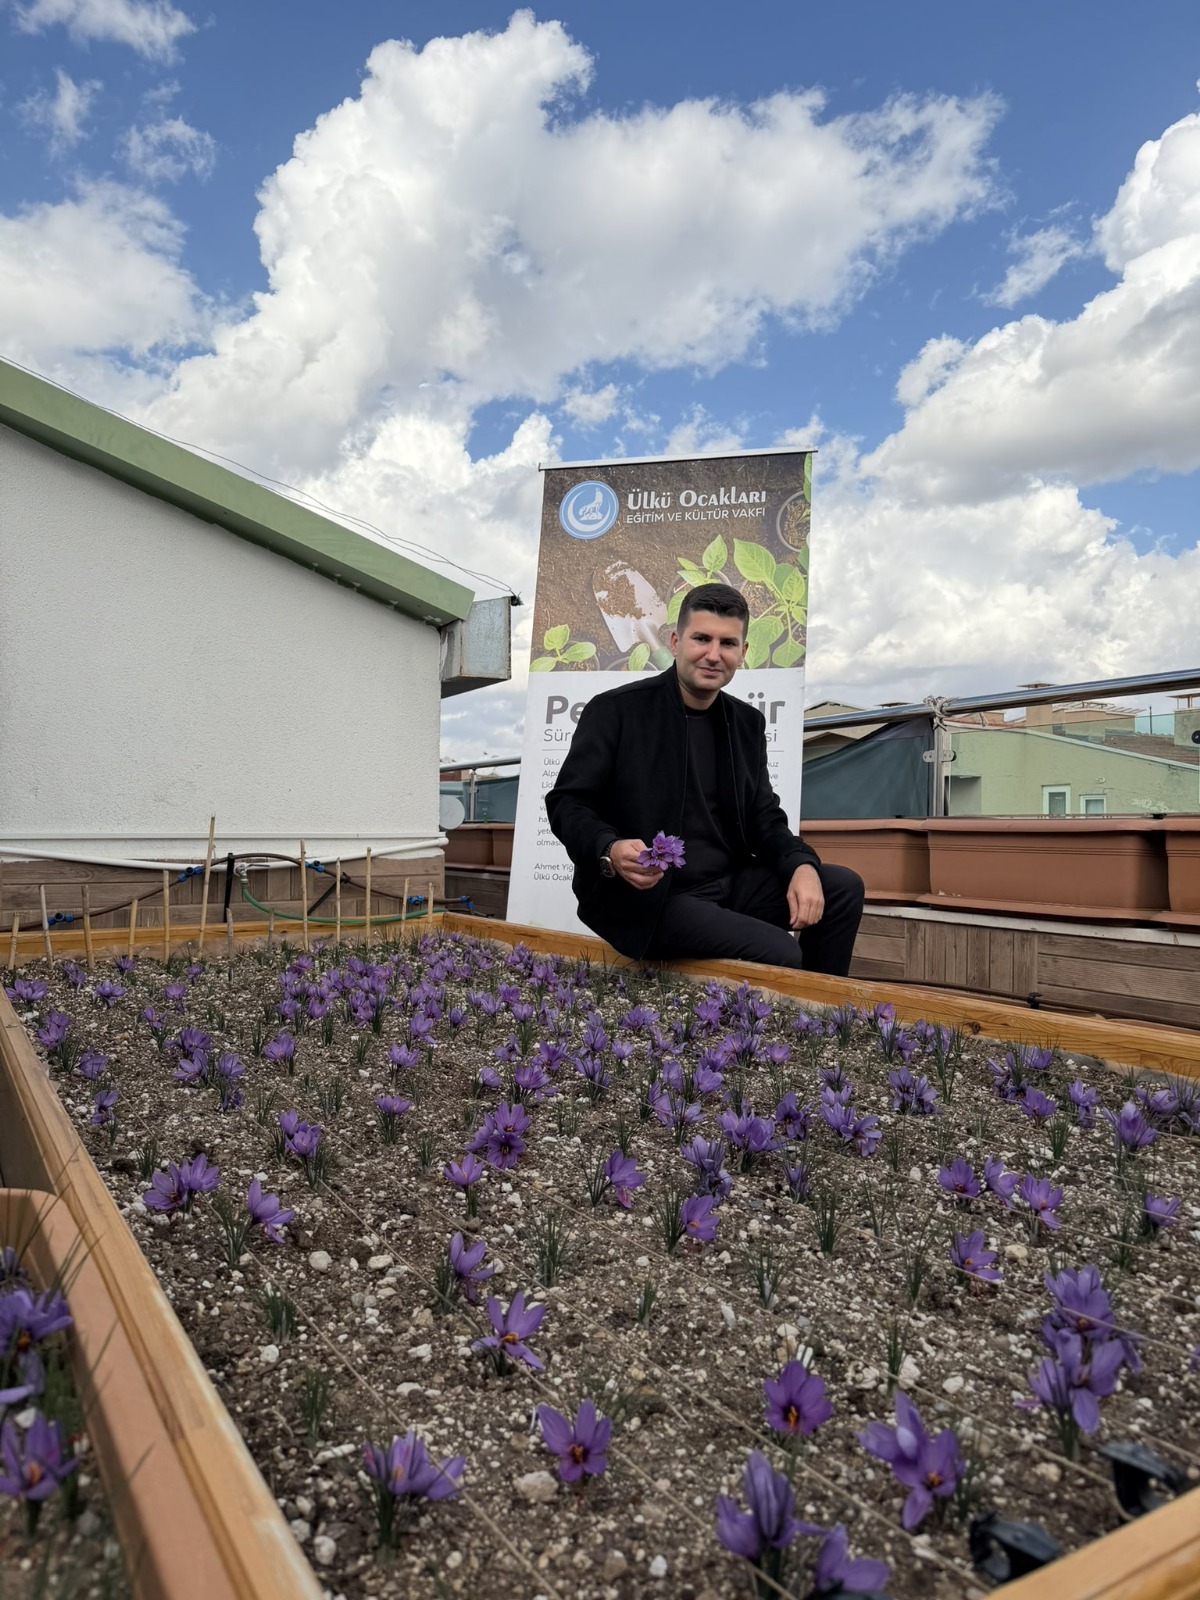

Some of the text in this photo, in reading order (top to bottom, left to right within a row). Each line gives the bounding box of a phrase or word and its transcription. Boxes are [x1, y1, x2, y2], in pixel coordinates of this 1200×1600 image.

[626, 507, 766, 524] EĞİTİM VE KÜLTÜR VAKFI
[534, 863, 560, 871] Ahmet
[533, 871, 551, 881] Ülkü
